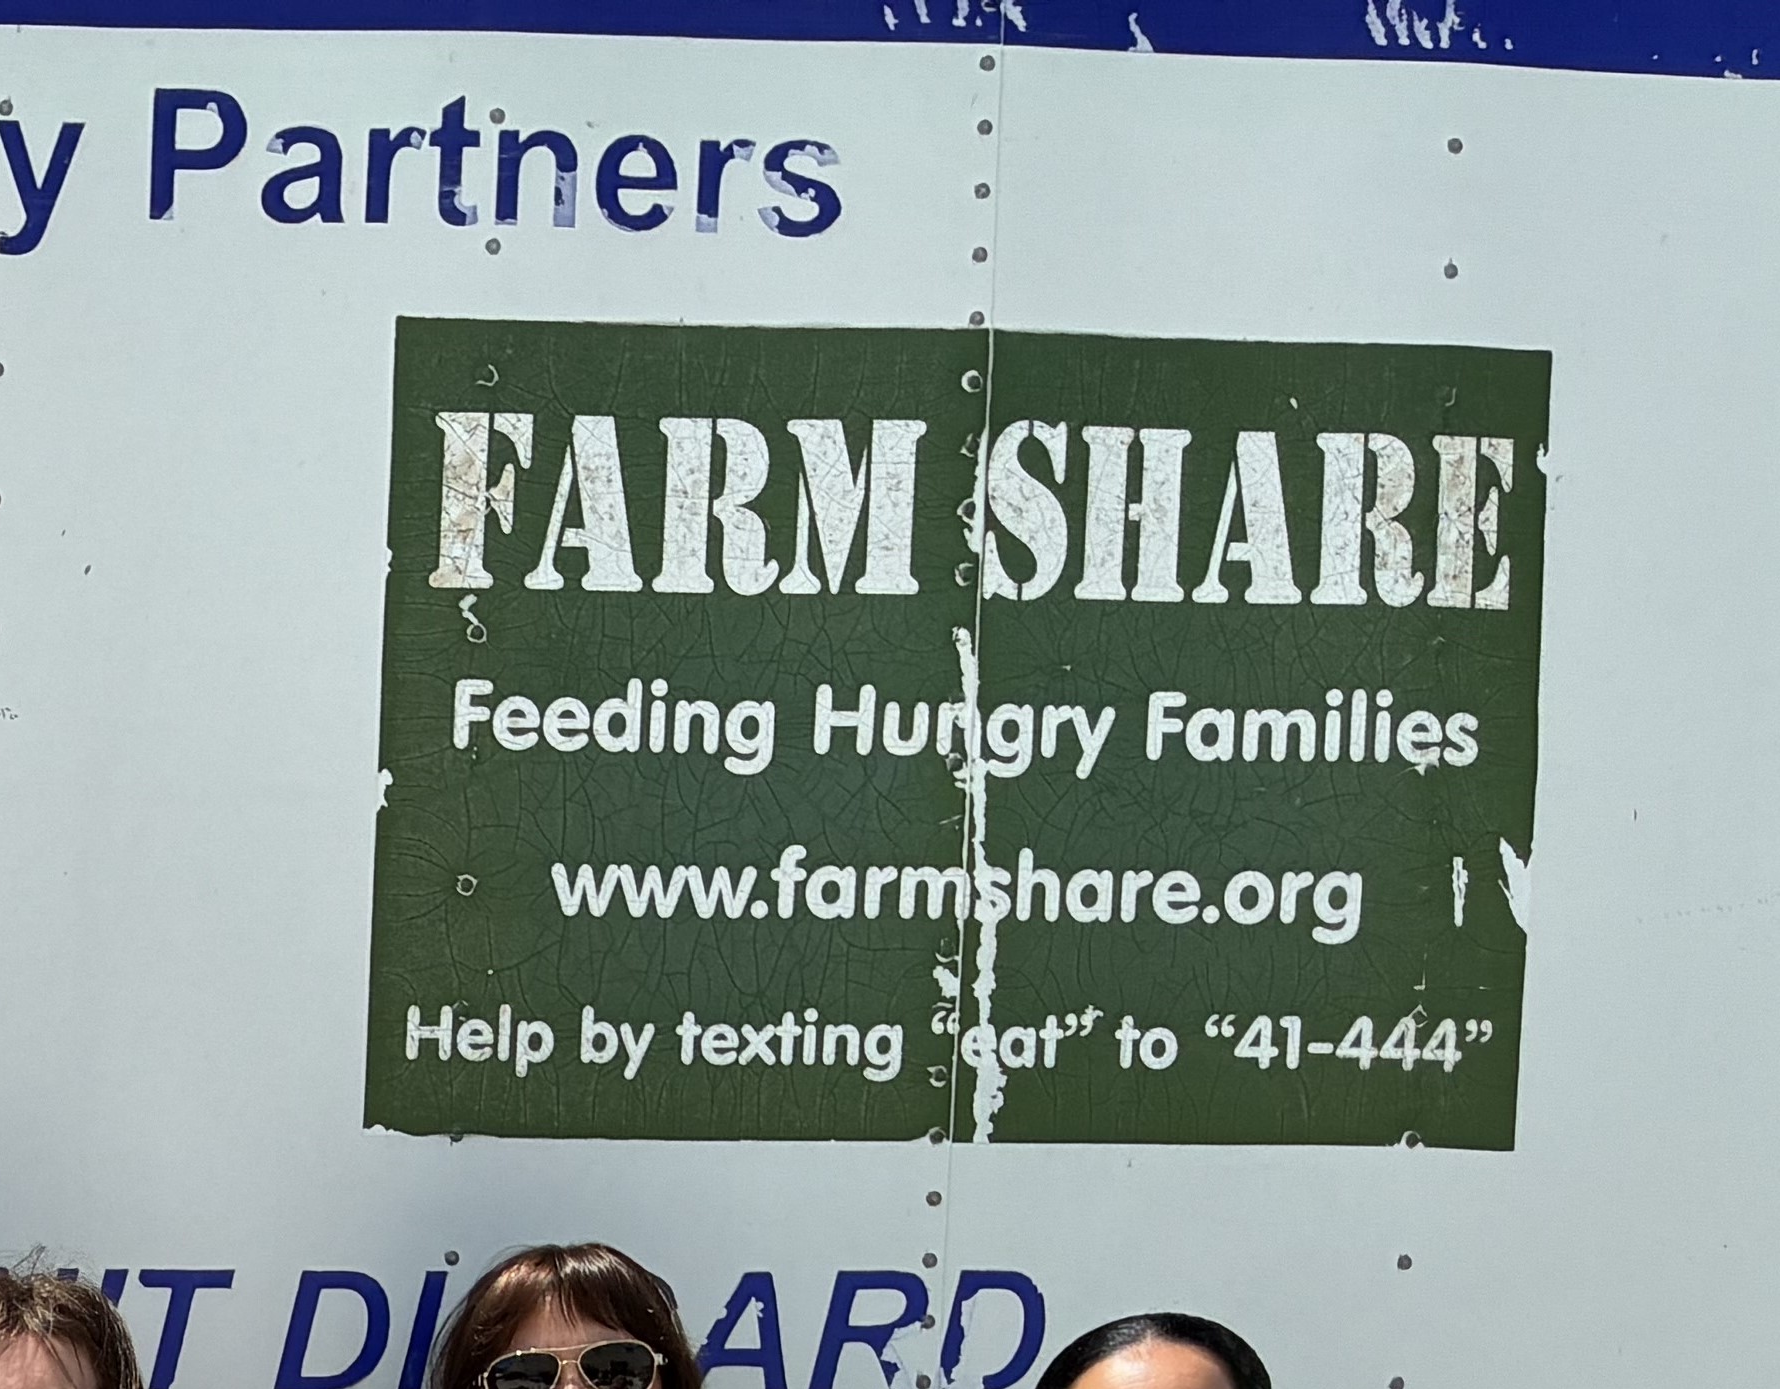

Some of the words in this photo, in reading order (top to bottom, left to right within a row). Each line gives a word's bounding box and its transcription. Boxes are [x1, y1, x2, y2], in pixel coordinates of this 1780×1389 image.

[147, 85, 845, 240] Partners
[426, 411, 926, 598] FARM
[979, 418, 1516, 610] SHARE
[452, 681, 777, 775] Feeding
[814, 684, 1117, 779] Hungry
[1146, 689, 1481, 769] Families
[551, 845, 1364, 946] www.farmshare.org
[403, 1006, 566, 1076] Help
[579, 1006, 655, 1080] by
[676, 1010, 905, 1080] texting
[1119, 1016, 1178, 1070] to
